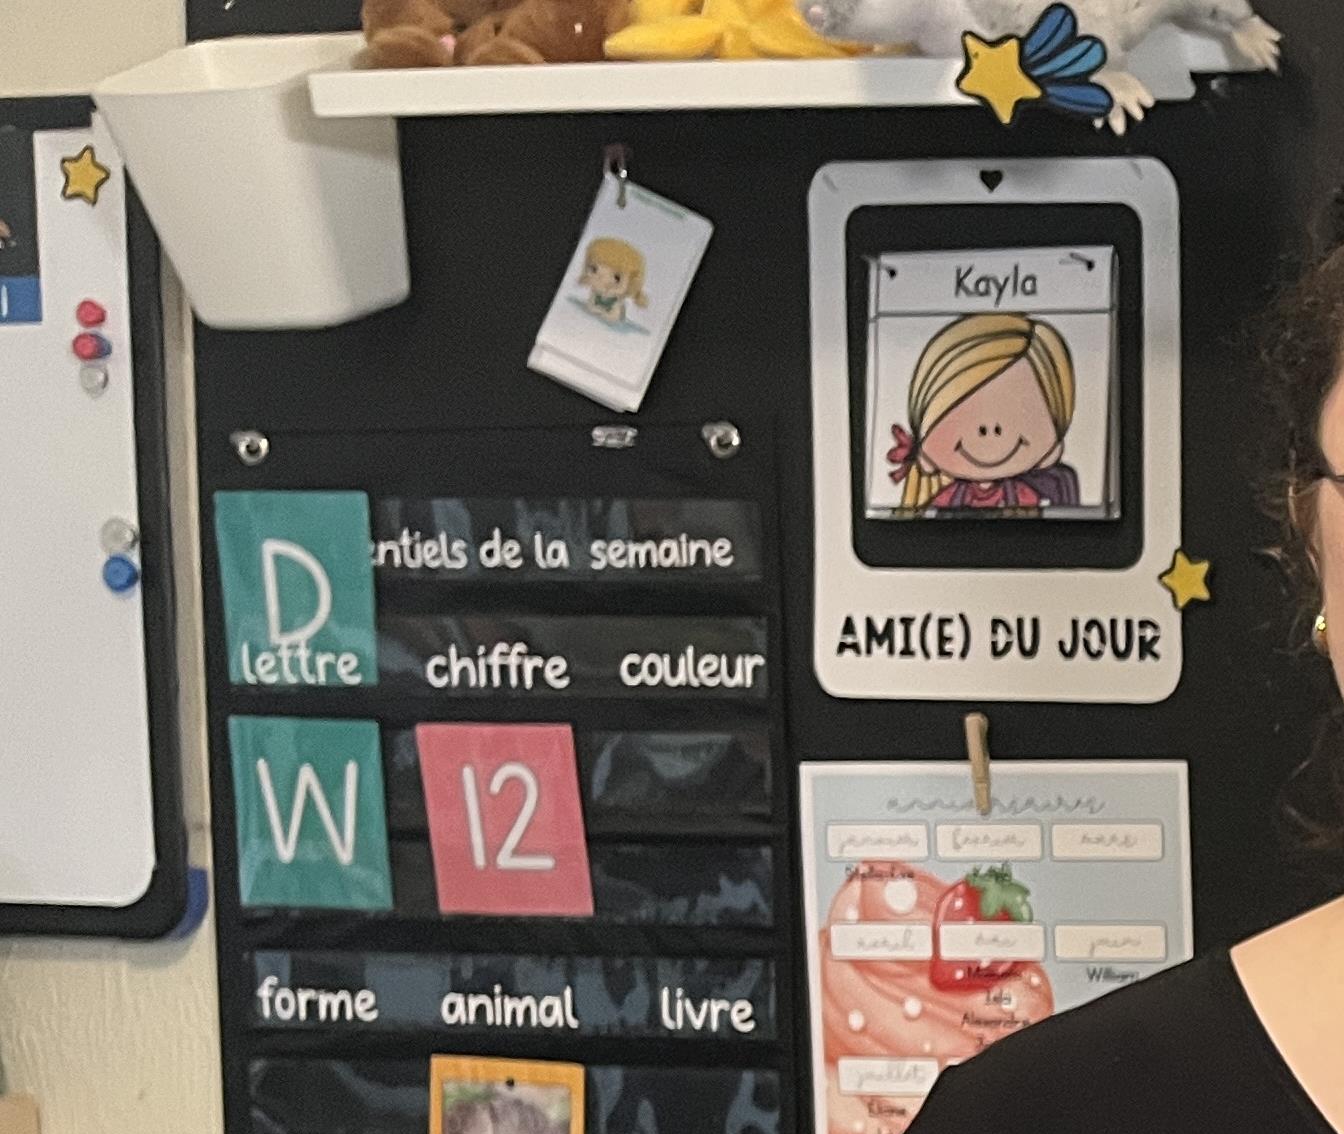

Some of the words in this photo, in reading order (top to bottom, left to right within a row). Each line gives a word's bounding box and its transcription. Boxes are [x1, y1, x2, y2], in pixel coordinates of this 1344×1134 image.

[954, 264, 1038, 307] Kayla
[479, 527, 523, 569] de
[534, 530, 570, 570] la
[590, 532, 734, 571] semaine
[262, 538, 331, 643] D
[836, 612, 971, 660] AMI(E)
[990, 616, 1040, 660] DU
[1058, 617, 1162, 662] JOUR
[241, 641, 363, 686] lettre
[426, 641, 570, 690] chiffre
[619, 644, 767, 689] couleur
[256, 757, 358, 866] W
[461, 762, 556, 871] 12
[255, 975, 379, 1022] forme
[440, 983, 580, 1030] animal
[659, 986, 758, 1034] livre
